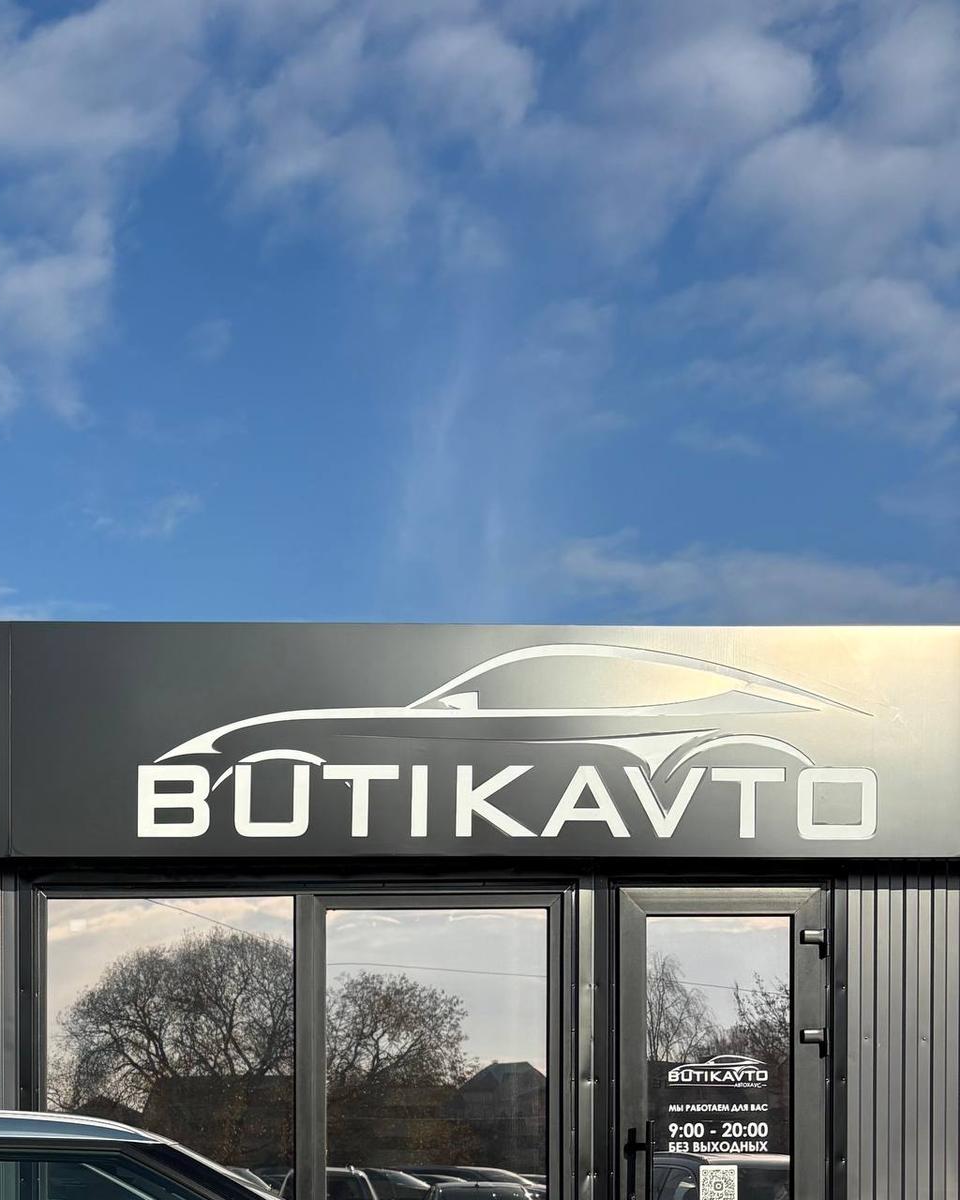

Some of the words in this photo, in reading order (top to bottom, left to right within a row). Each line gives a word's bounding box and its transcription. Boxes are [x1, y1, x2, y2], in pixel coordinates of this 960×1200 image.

[136, 763, 878, 840] BUTIKAVTO
[668, 1070, 768, 1082] BUTIKAVTO
[669, 1104, 683, 1112] МЫ
[685, 1104, 730, 1112] РАБОТАЕМ
[731, 1104, 749, 1112] ДЛЯ
[668, 1122, 705, 1138] 9:00
[721, 1122, 769, 1138] 20:00
[668, 1141, 689, 1153] БЕЗ
[693, 1141, 768, 1153] ВЫХОДНЫХ
